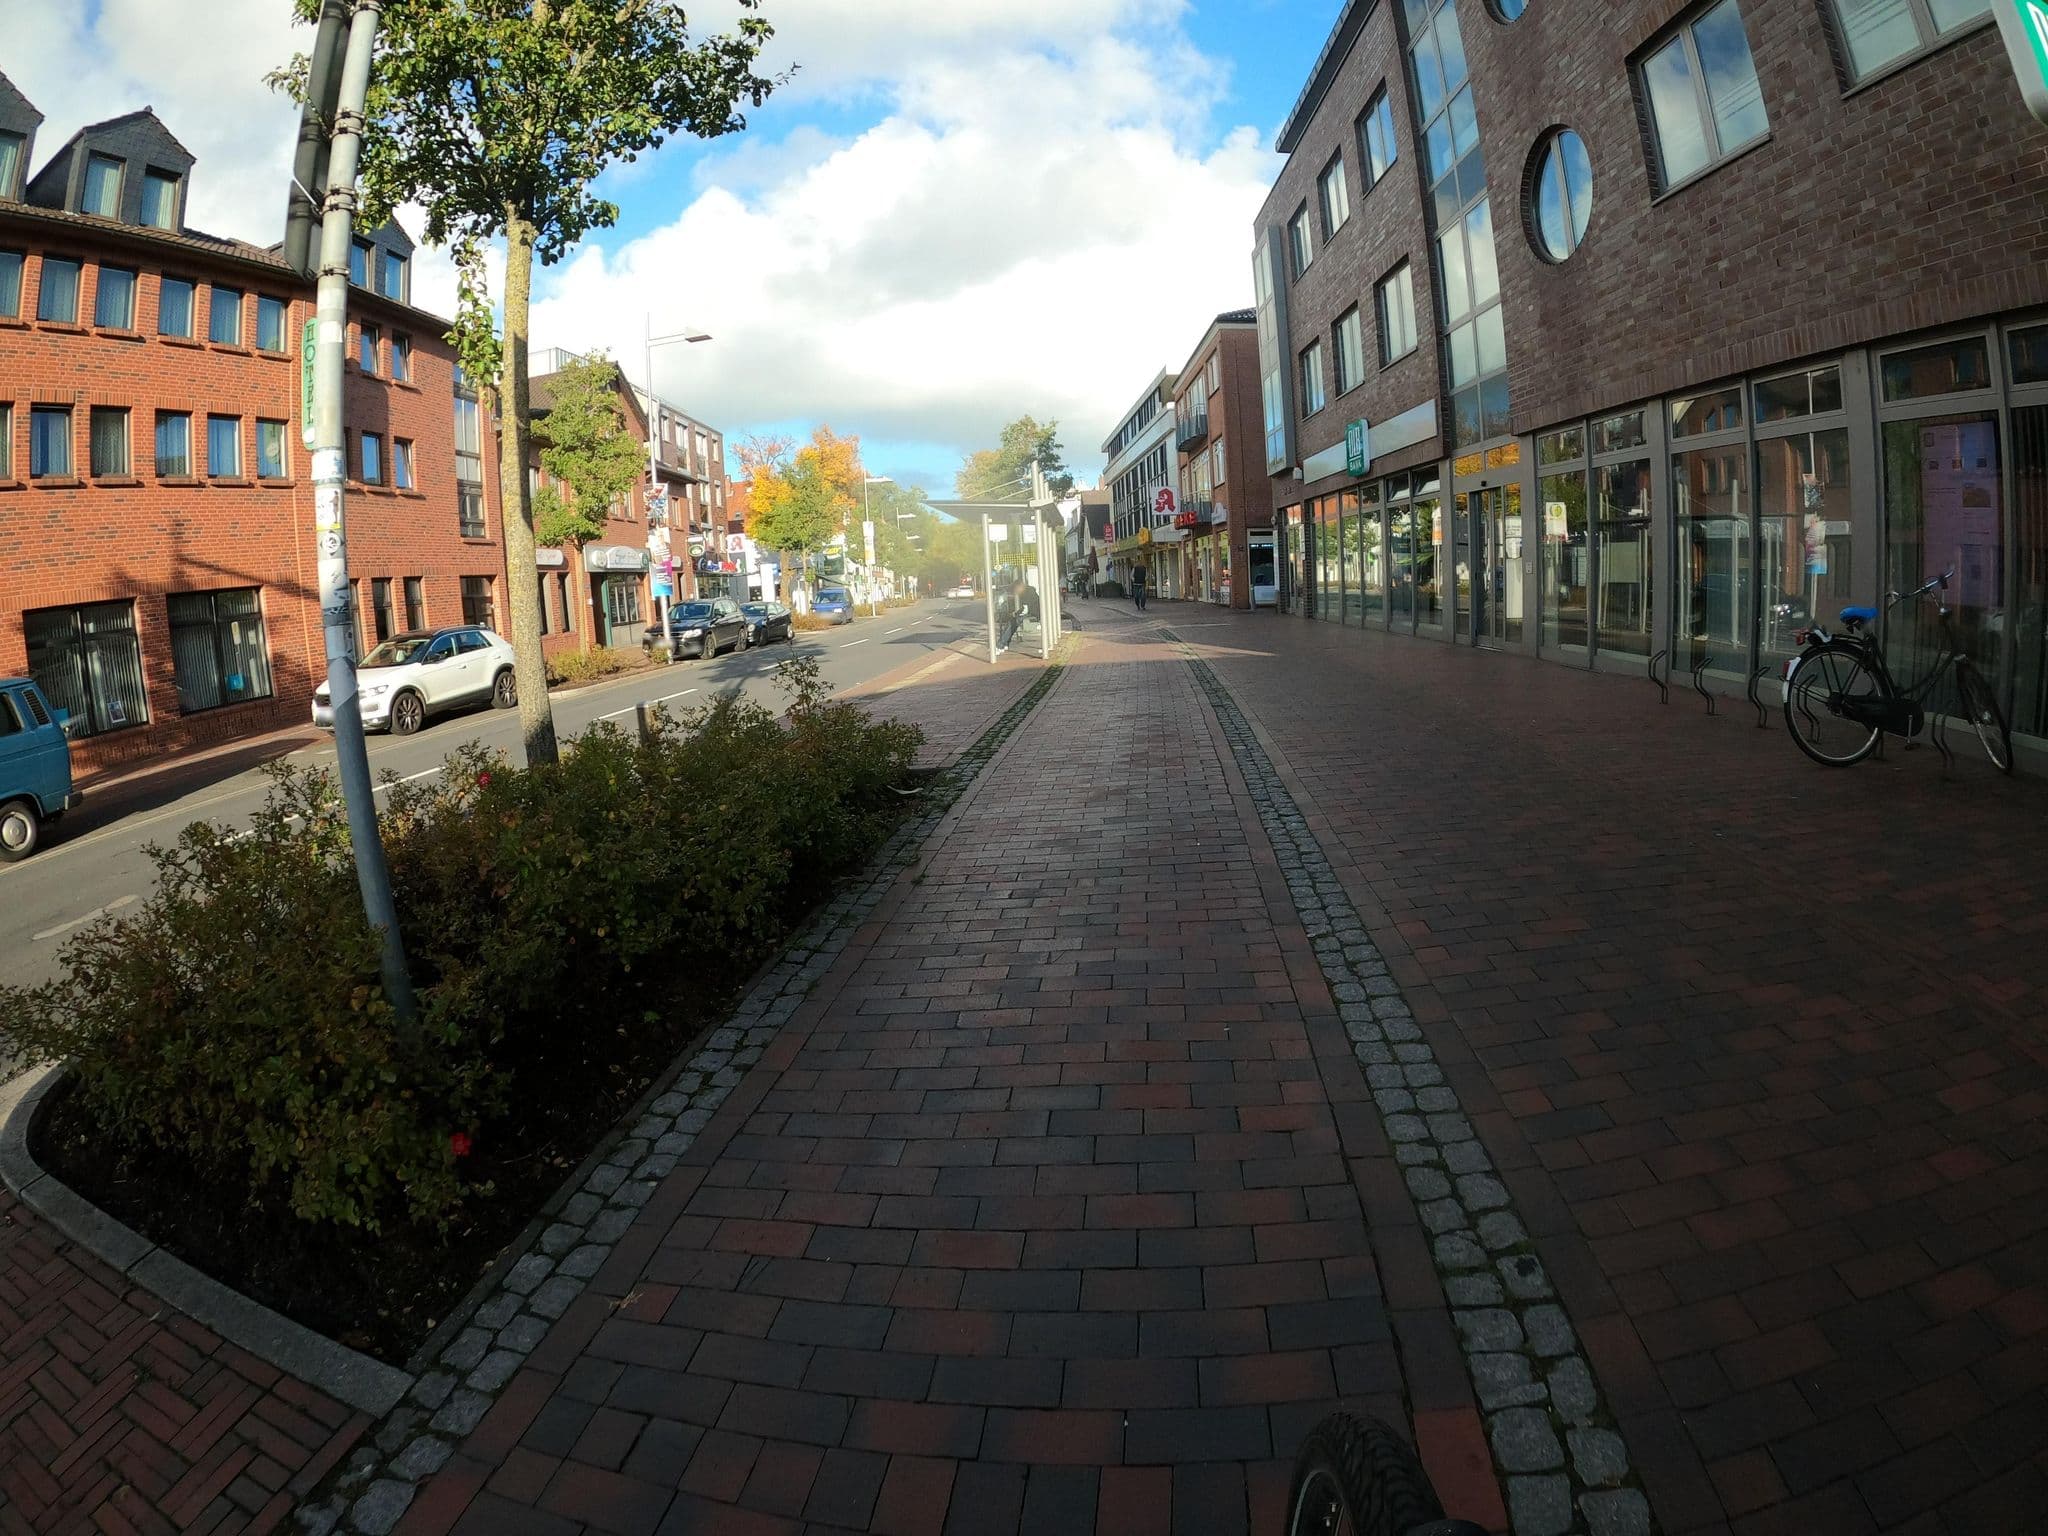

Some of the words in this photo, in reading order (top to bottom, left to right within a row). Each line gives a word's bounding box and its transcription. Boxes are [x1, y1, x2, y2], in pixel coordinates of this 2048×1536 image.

[304, 323, 315, 425] HOTEL
[1348, 426, 1361, 458] OLB
[1154, 487, 1176, 513] A
